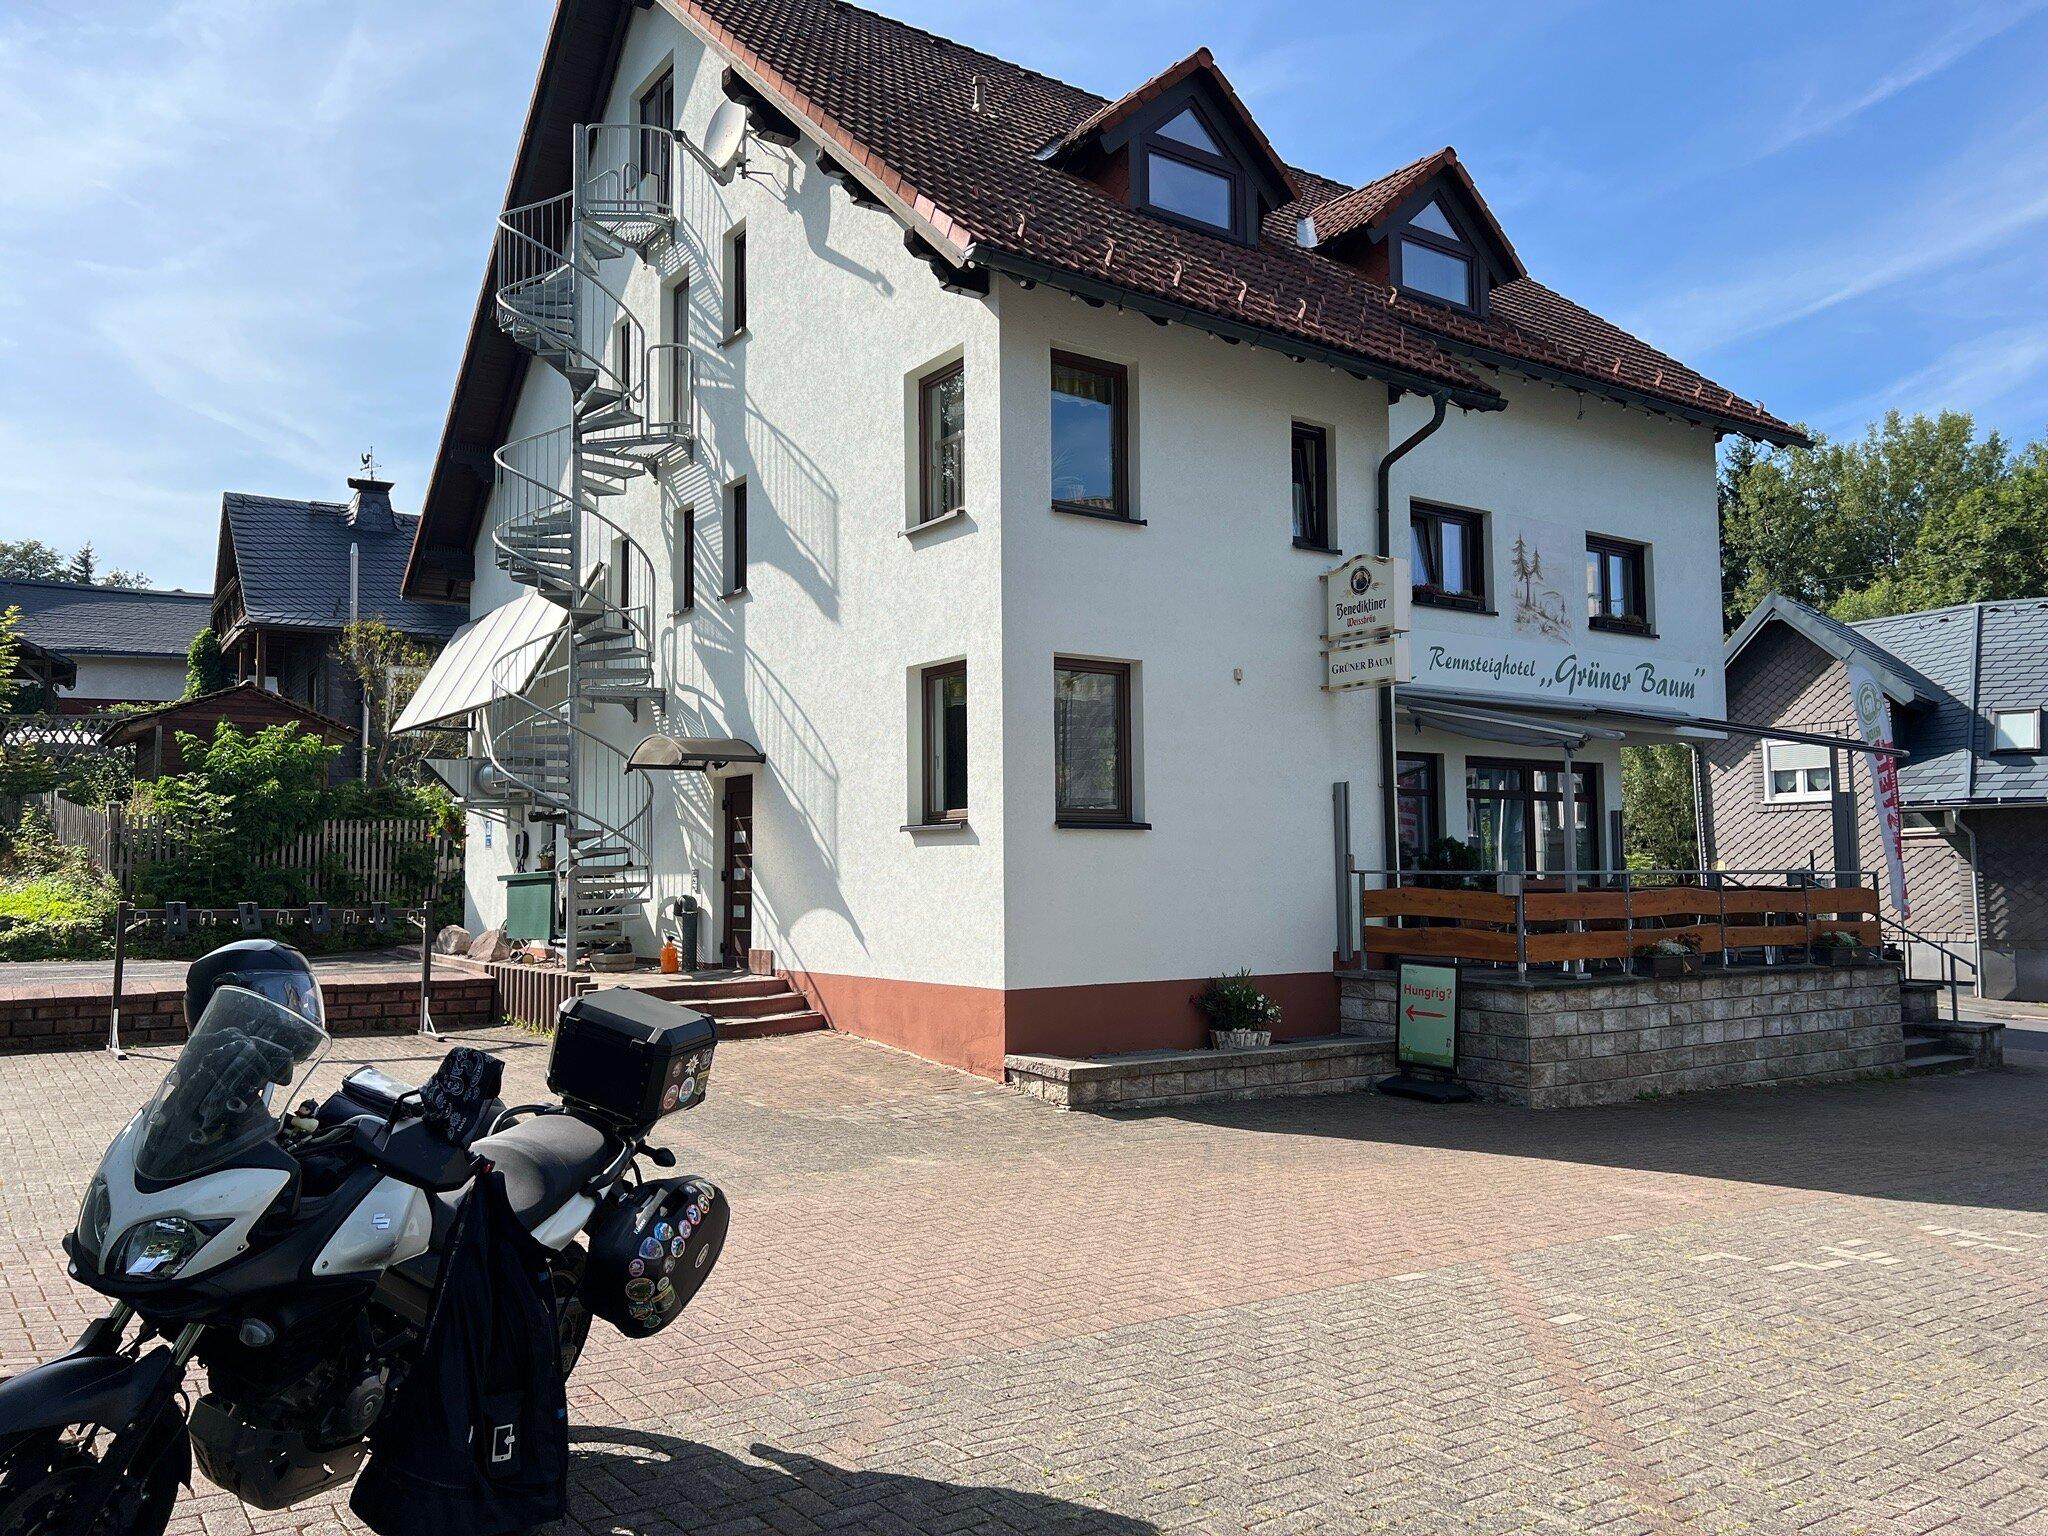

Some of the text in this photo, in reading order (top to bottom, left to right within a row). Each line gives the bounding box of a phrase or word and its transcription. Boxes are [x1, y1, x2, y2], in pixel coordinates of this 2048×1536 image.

[1335, 599, 1387, 620] Benediktiner
[1331, 657, 1393, 675] GRÜNER BAUM
[1429, 646, 1536, 680] Rennsteighotel
[1404, 985, 1452, 1001] Hungrig?
